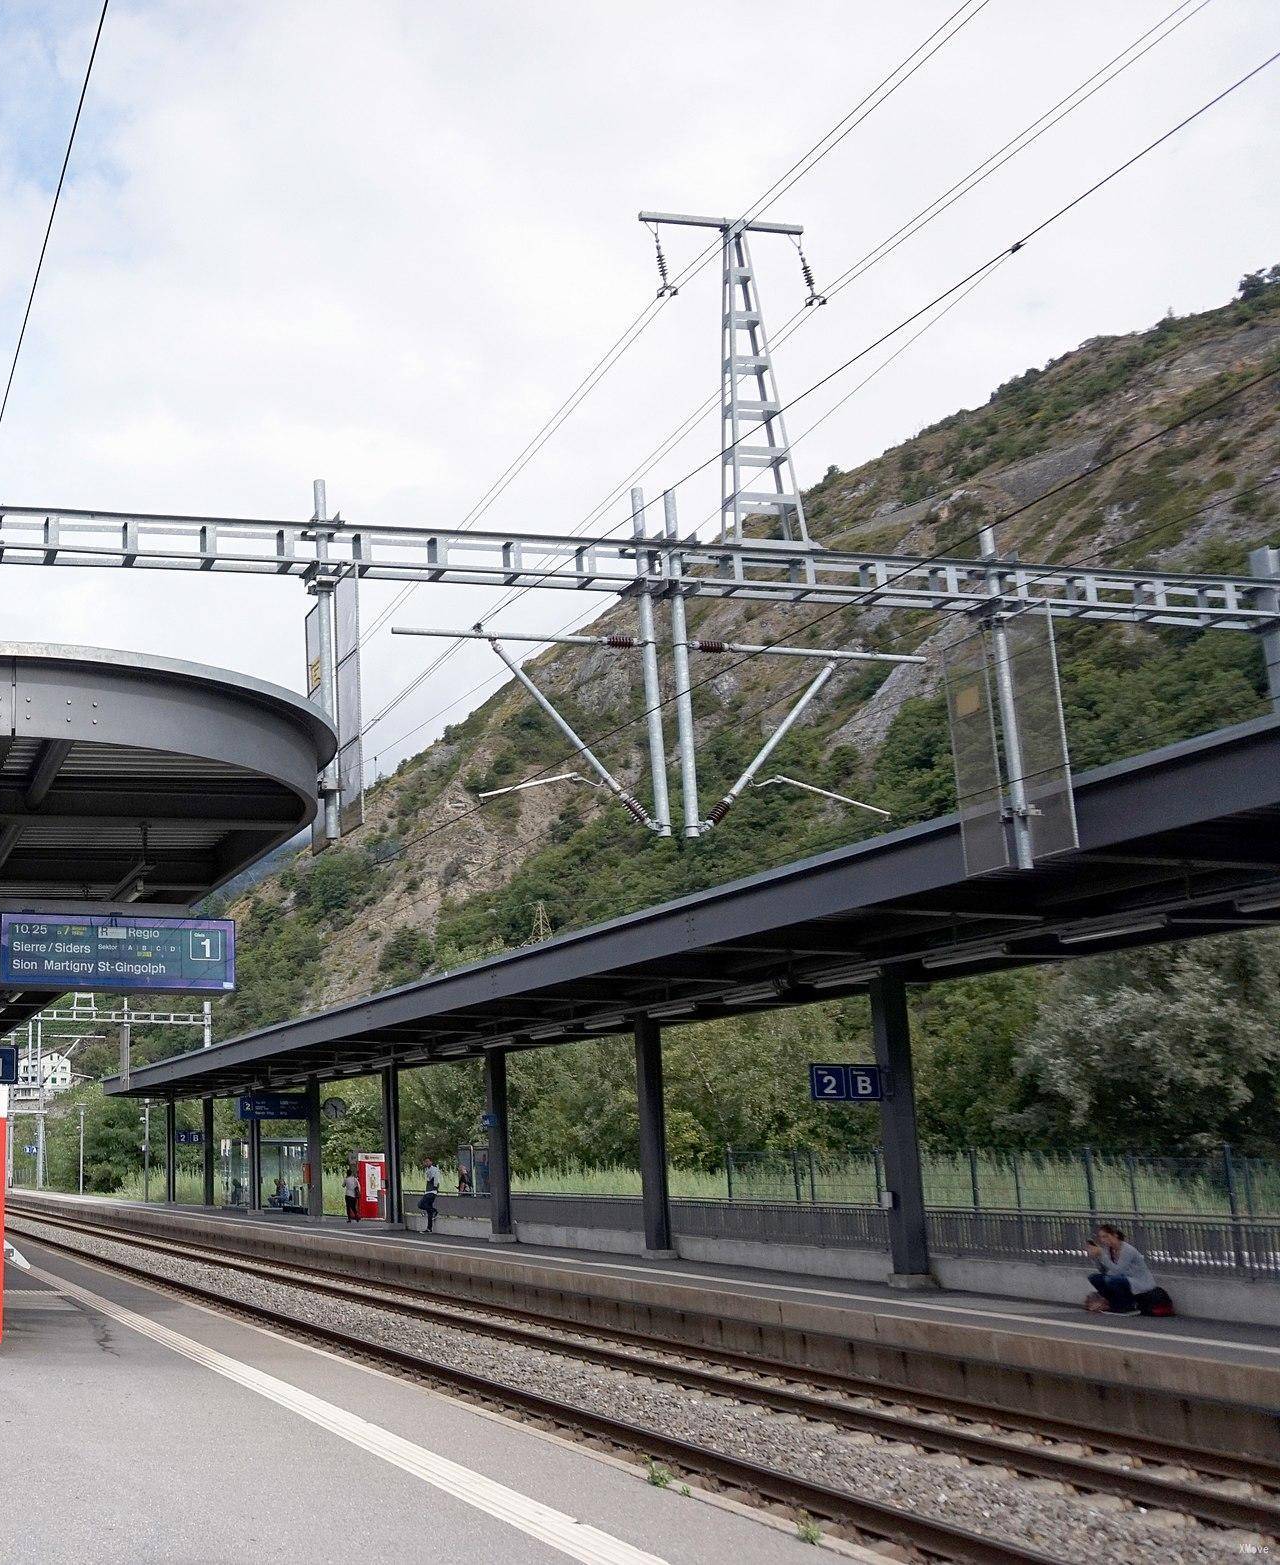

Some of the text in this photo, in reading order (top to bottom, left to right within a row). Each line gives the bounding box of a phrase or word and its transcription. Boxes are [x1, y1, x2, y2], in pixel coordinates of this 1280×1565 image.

[14, 924, 48, 935] 10.25
[128, 927, 160, 940] Regio
[200, 938, 211, 958] 1
[12, 959, 166, 974] Sion Martigny St-Gingolph
[822, 1075, 873, 1094] 2 B
